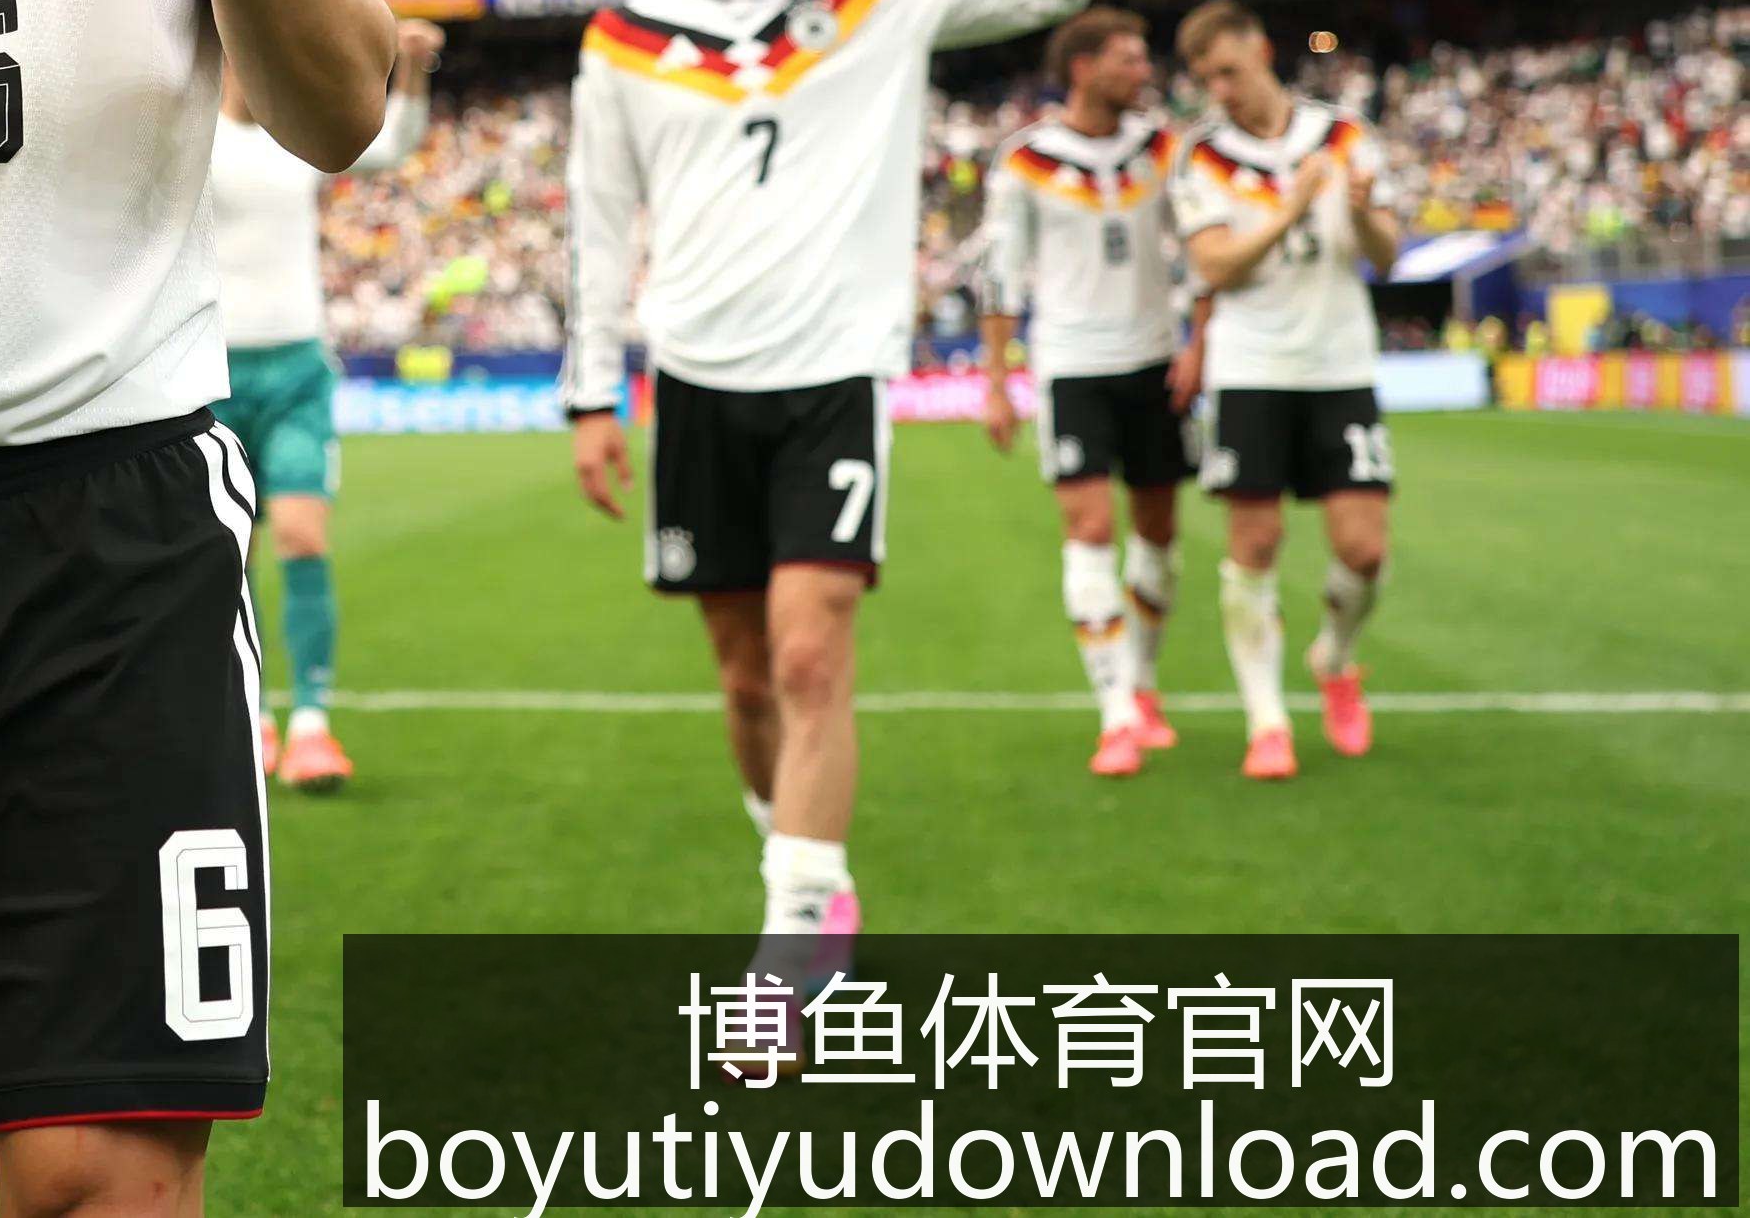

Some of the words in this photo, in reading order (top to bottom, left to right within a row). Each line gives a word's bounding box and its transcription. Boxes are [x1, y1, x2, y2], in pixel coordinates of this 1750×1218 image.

[742, 116, 779, 185] 7
[828, 458, 874, 543] 7
[159, 829, 253, 1041] 6
